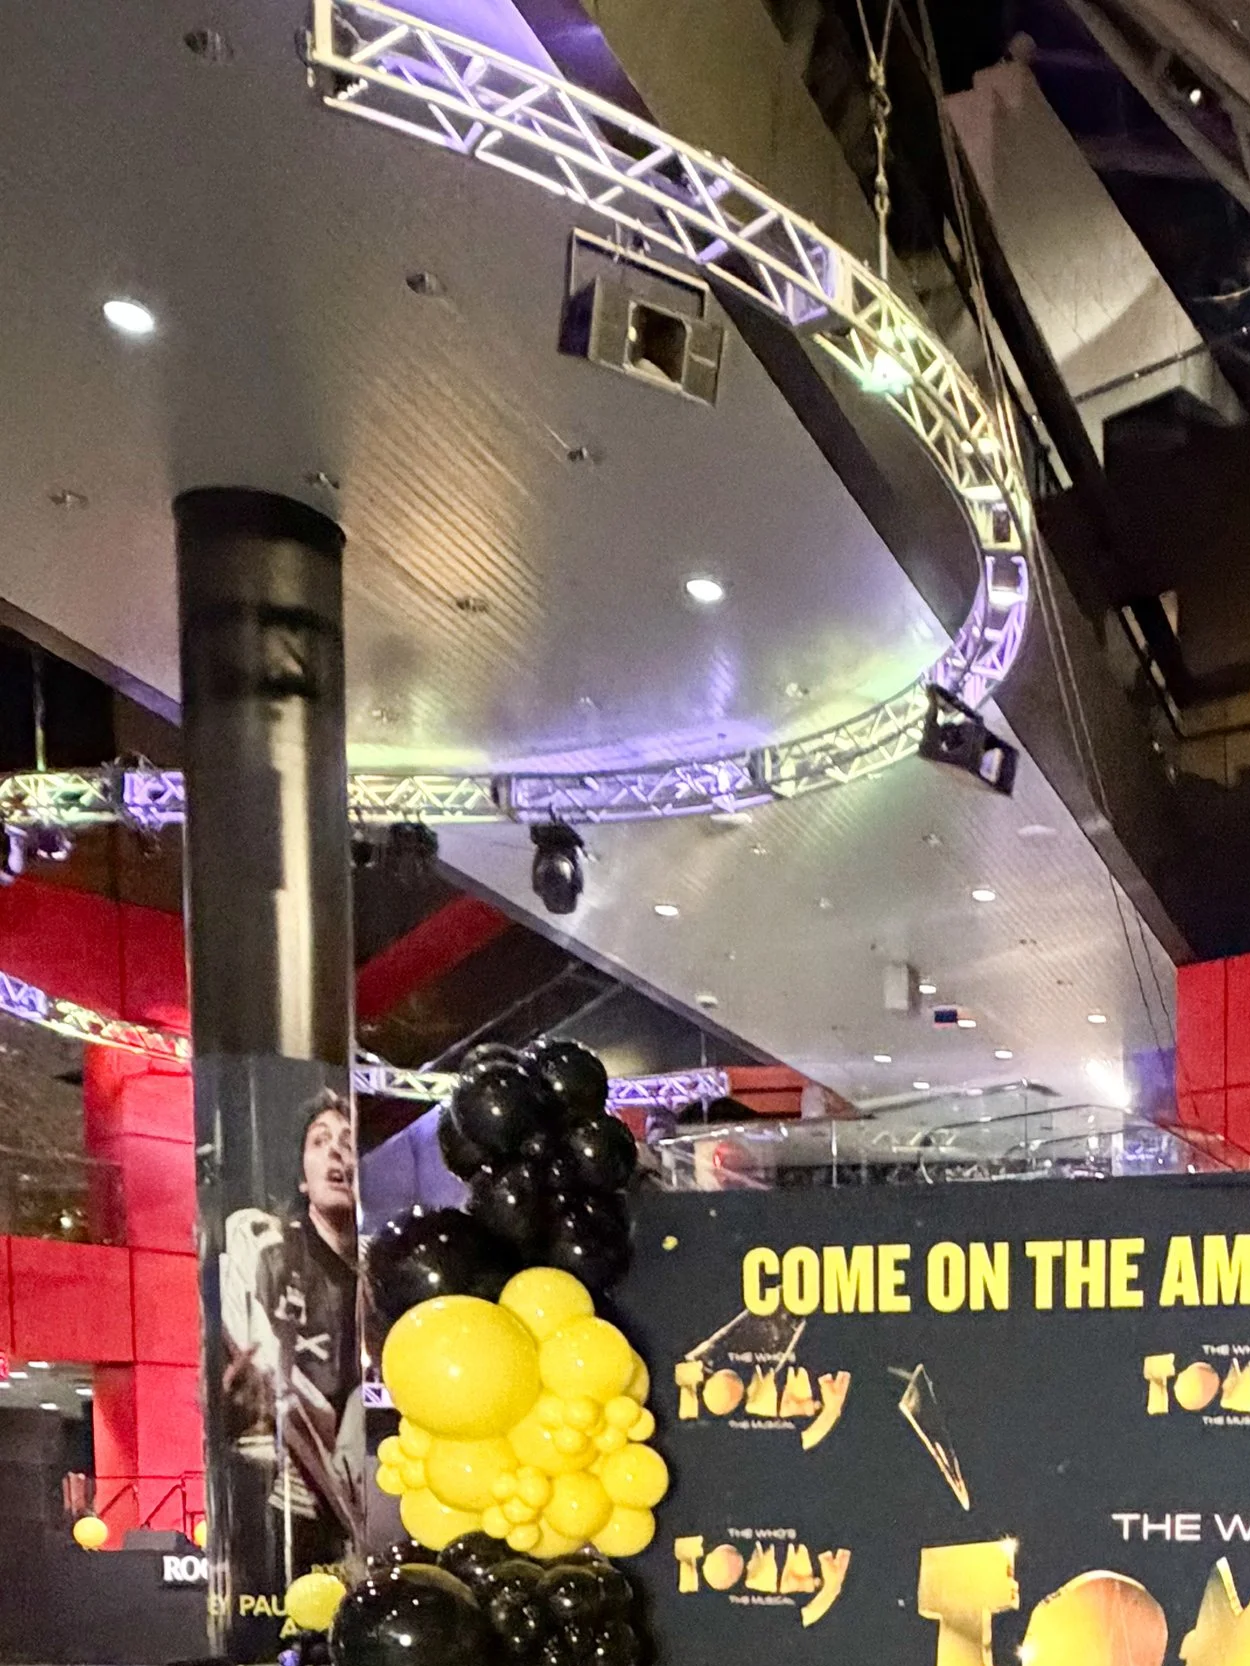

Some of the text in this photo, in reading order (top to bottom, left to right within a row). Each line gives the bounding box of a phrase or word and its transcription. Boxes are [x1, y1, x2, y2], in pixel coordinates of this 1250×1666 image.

[742, 1244, 911, 1317] COME
[926, 1241, 1010, 1312] ON
[1024, 1237, 1145, 1310] THE
[1202, 1344, 1230, 1356] THE
[1111, 1513, 1202, 1541] THE
[239, 1593, 286, 1616] PAU
